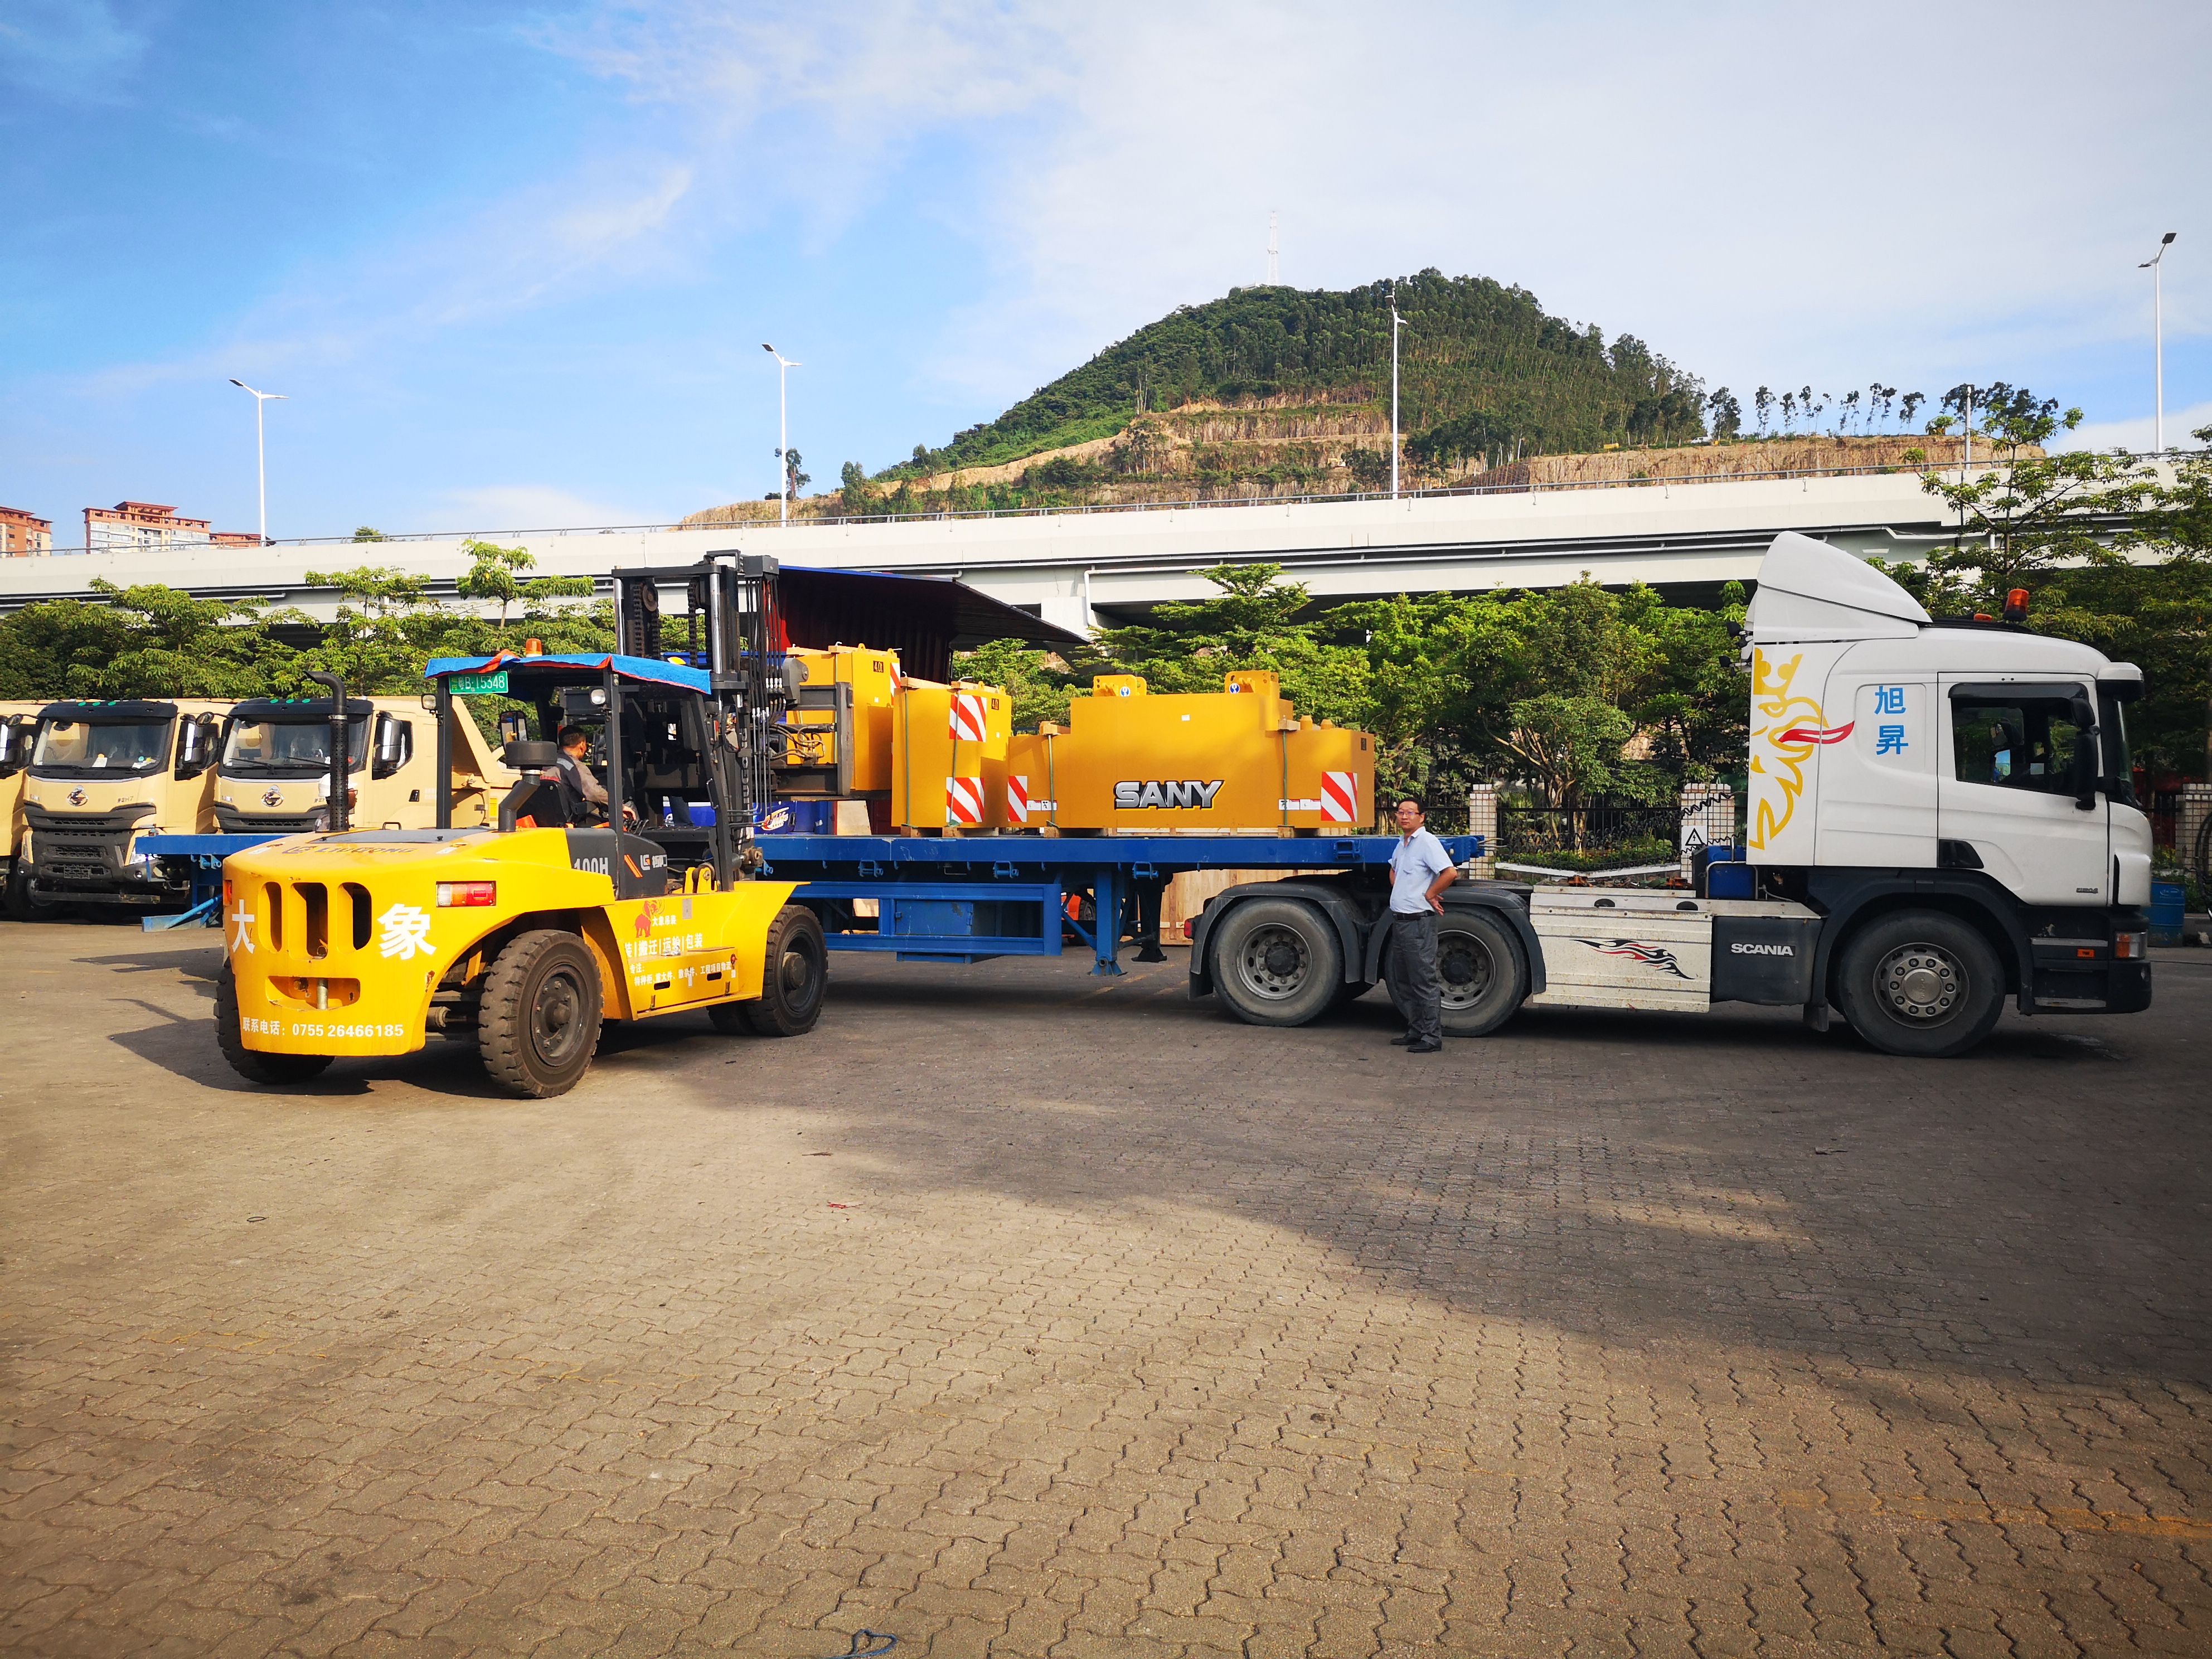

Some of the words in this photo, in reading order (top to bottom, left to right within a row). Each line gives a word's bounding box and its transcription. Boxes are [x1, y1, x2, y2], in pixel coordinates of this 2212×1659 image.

[1114, 780, 1224, 809] SANY
[652, 915, 676, 926] 大象吊装
[1731, 943, 1794, 956] SCANIA
[292, 1023, 324, 1036] 0755
[327, 1024, 404, 1037] 26466185
